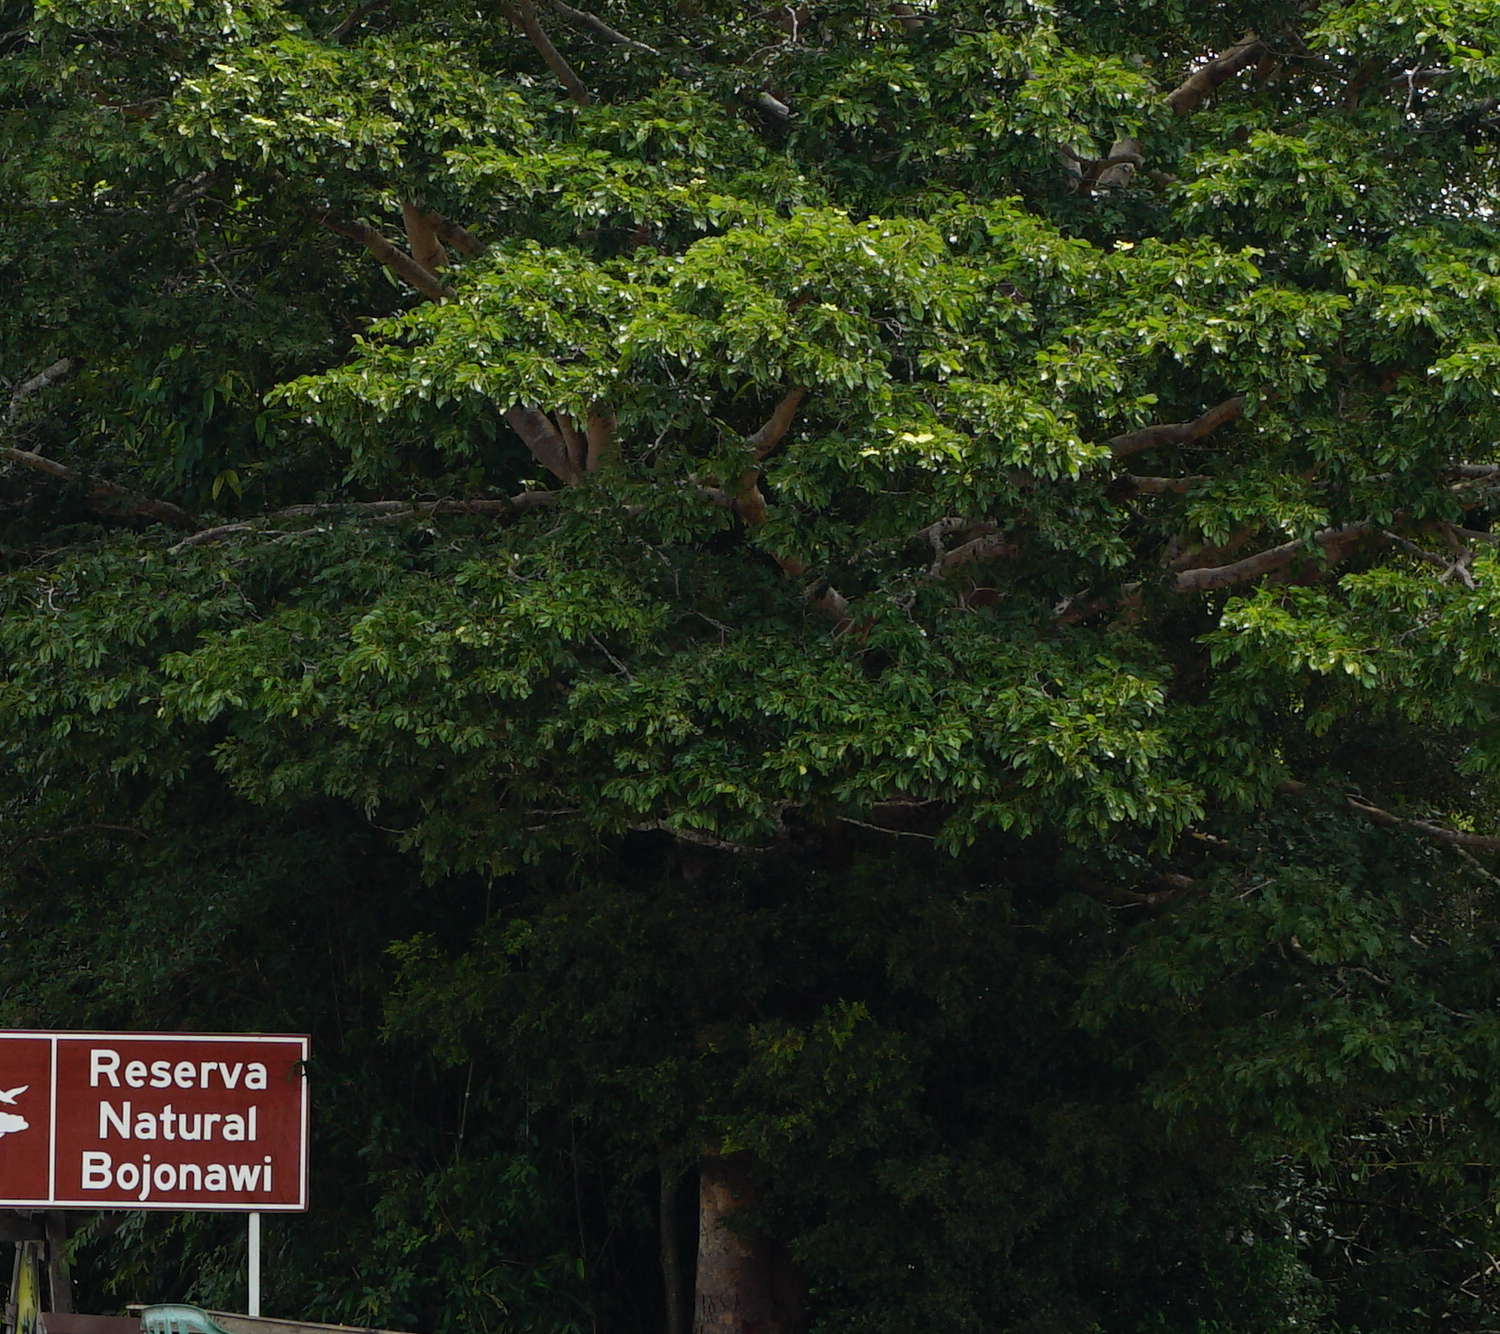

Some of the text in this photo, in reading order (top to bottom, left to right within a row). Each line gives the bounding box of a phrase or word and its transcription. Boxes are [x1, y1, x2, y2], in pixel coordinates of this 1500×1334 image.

[90, 1049, 267, 1090] Reserva
[99, 1101, 257, 1141] Natural
[81, 1151, 272, 1201] Bojonawi
